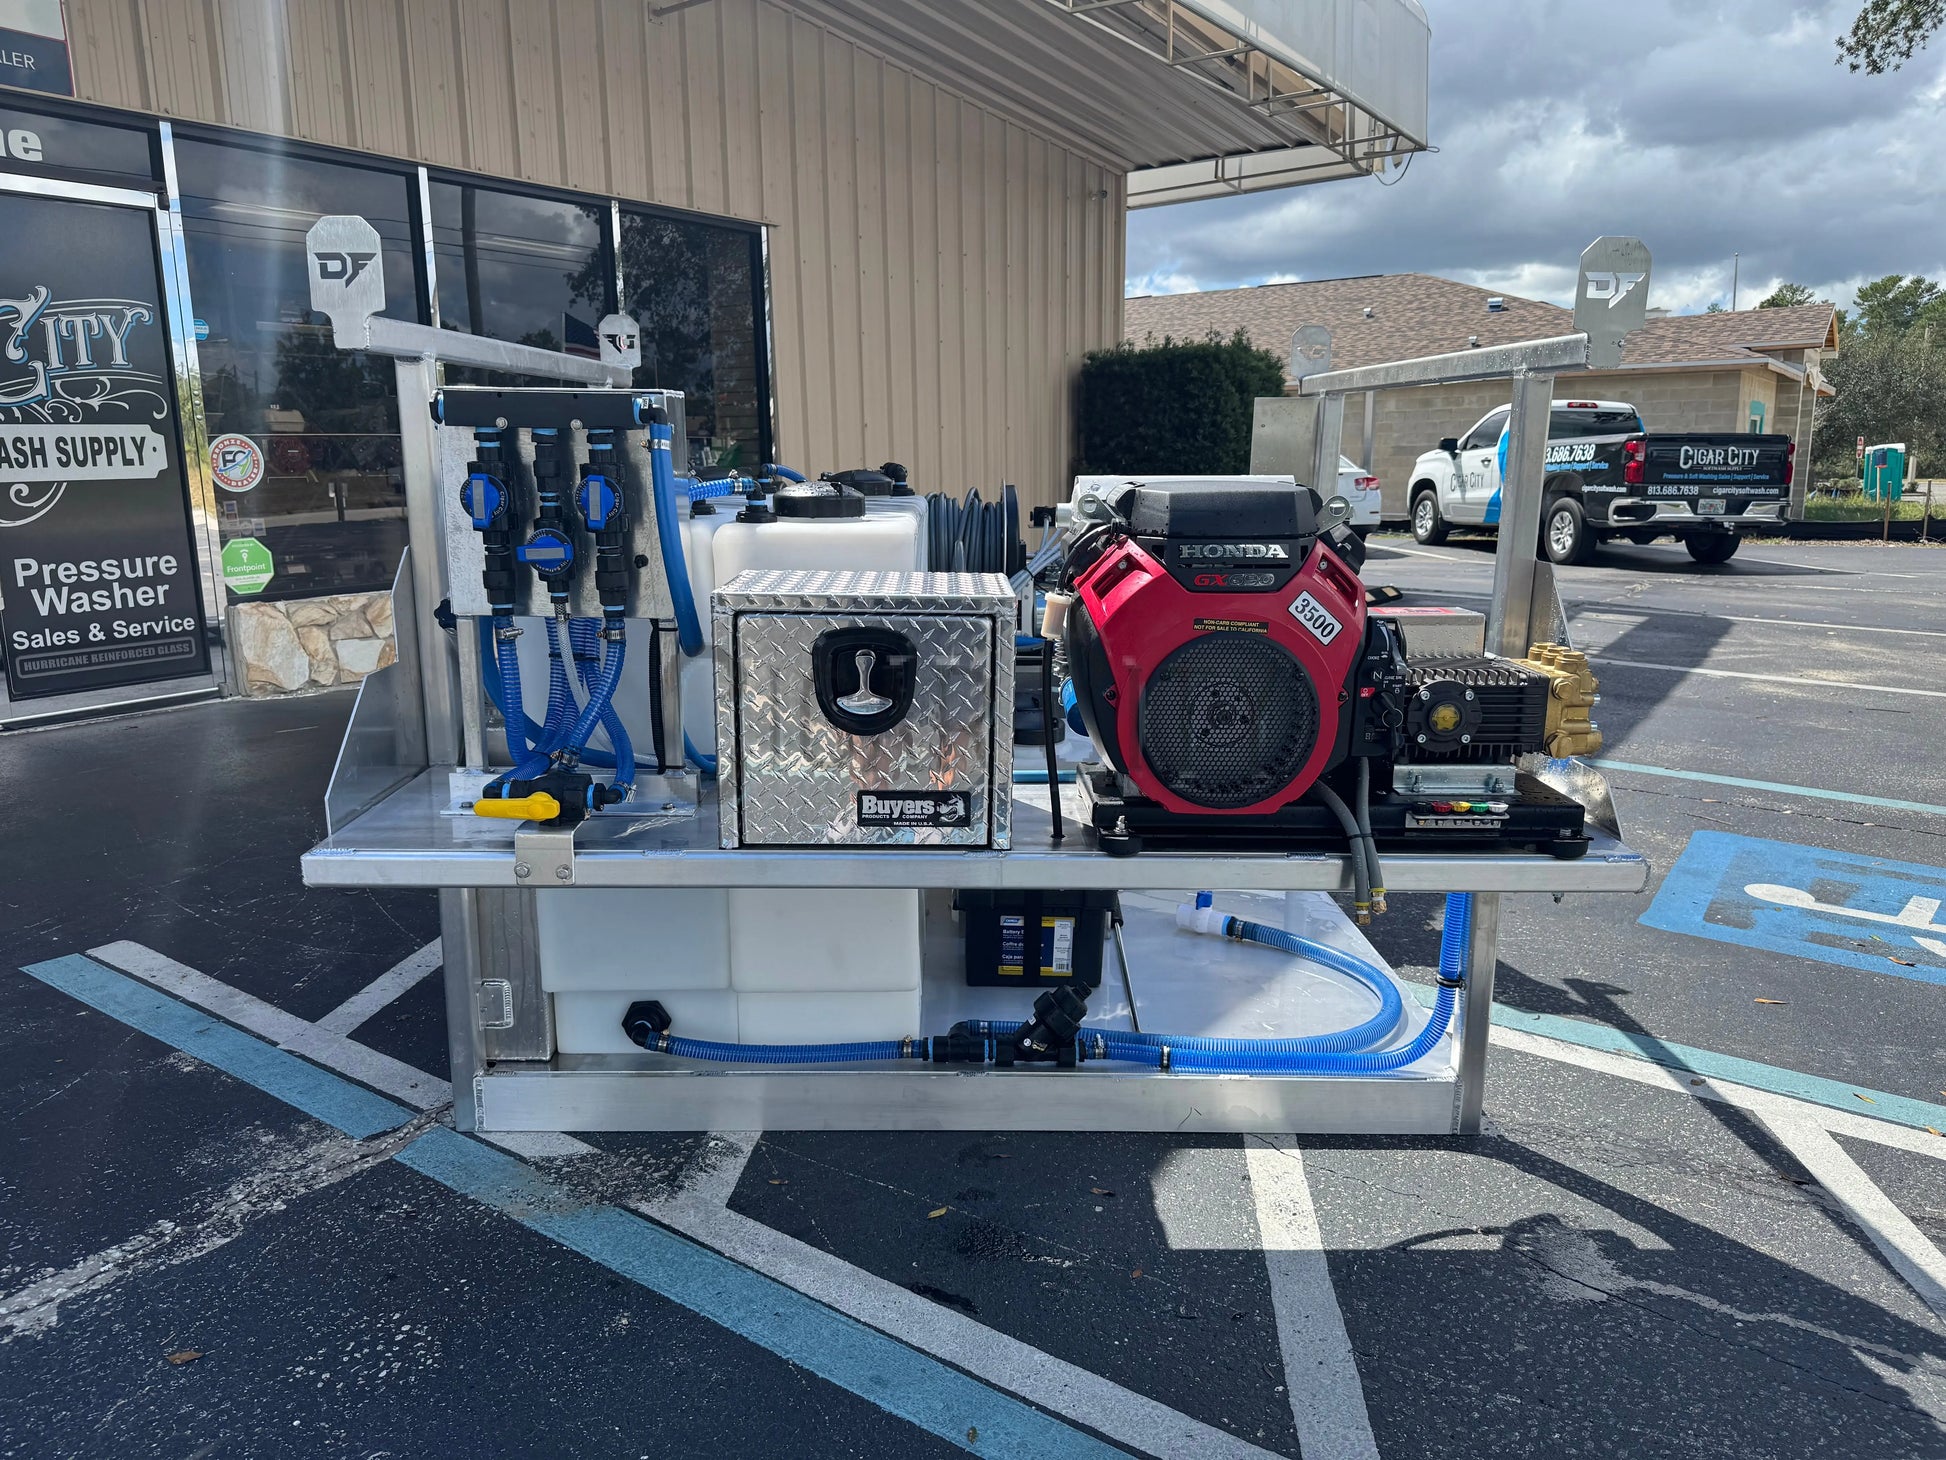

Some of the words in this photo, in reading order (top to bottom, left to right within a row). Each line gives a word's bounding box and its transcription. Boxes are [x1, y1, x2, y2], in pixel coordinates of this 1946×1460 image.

[0, 49, 36, 71] LER
[0, 128, 43, 162] e
[313, 252, 378, 289] DF
[1584, 271, 1647, 309] DF
[0, 436, 49, 470] ASH
[55, 436, 146, 468] SUPPLY
[212, 439, 241, 459] BRONZE
[1545, 444, 1596, 463] 3.686.7638
[1680, 446, 1724, 469] CIGAR
[1728, 446, 1759, 466] CITY
[231, 468, 258, 486] DEALER
[1647, 486, 1699, 496] 813.686.7638
[1712, 487, 1779, 496] cigarcitysoftwash.com
[1179, 544, 1289, 558] HONDA
[13, 554, 178, 587] Pressure
[226, 563, 266, 573] Frontpoint
[30, 582, 170, 617] Washer
[1294, 598, 1335, 638] 3500
[12, 628, 81, 650] Sales
[88, 623, 107, 641] &
[113, 616, 196, 639] Service
[23, 657, 90, 672] HURRICANE
[90, 649, 156, 664] REINFORCED
[157, 643, 190, 656] GLASS
[861, 795, 935, 818] Buyers
